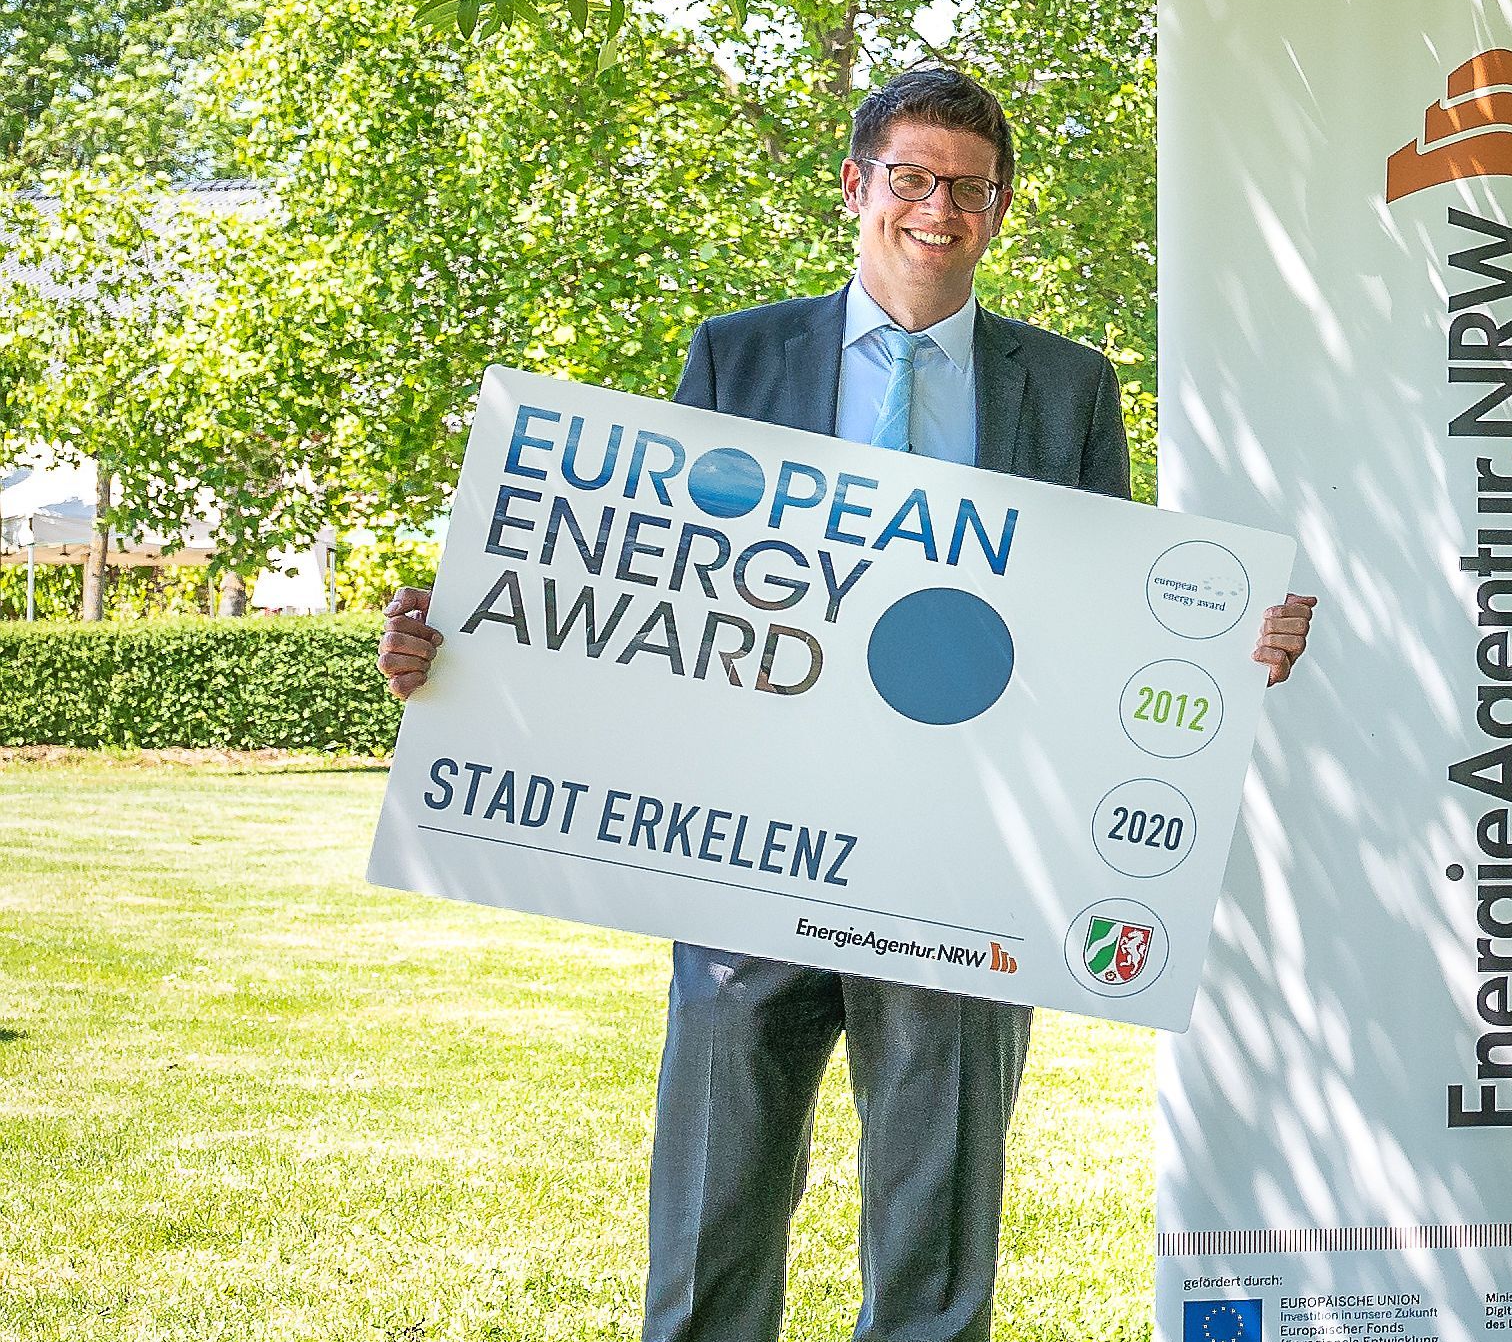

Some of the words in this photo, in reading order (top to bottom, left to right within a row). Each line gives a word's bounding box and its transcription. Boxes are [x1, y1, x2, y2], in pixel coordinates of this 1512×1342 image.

[503, 403, 1020, 575] EUROPEAN
[484, 484, 873, 624] ENERGY
[1154, 576, 1198, 592] european
[1163, 592, 1195, 607] energy
[1197, 599, 1226, 611] award
[460, 569, 825, 697] AWARD
[1132, 686, 1211, 734] 2012
[422, 757, 590, 834] STADT
[597, 790, 860, 887] ERKELENZ
[1107, 807, 1184, 852] 2020
[795, 916, 988, 969] EnergieAgentur.NRW
[1183, 1276, 1241, 1290] gefördert
[1243, 1275, 1283, 1287] durch:
[1280, 1295, 1374, 1309] EUROPÄISCHE
[1376, 1294, 1420, 1306] UNION
[1280, 1310, 1339, 1322] Investition
[1341, 1310, 1351, 1321] in
[1353, 1310, 1392, 1320] unsere
[1395, 1308, 1438, 1319] Zukunft
[1280, 1324, 1363, 1338] Europäischer
[1366, 1322, 1405, 1334] Fonds
[1485, 1319, 1506, 1330] des
